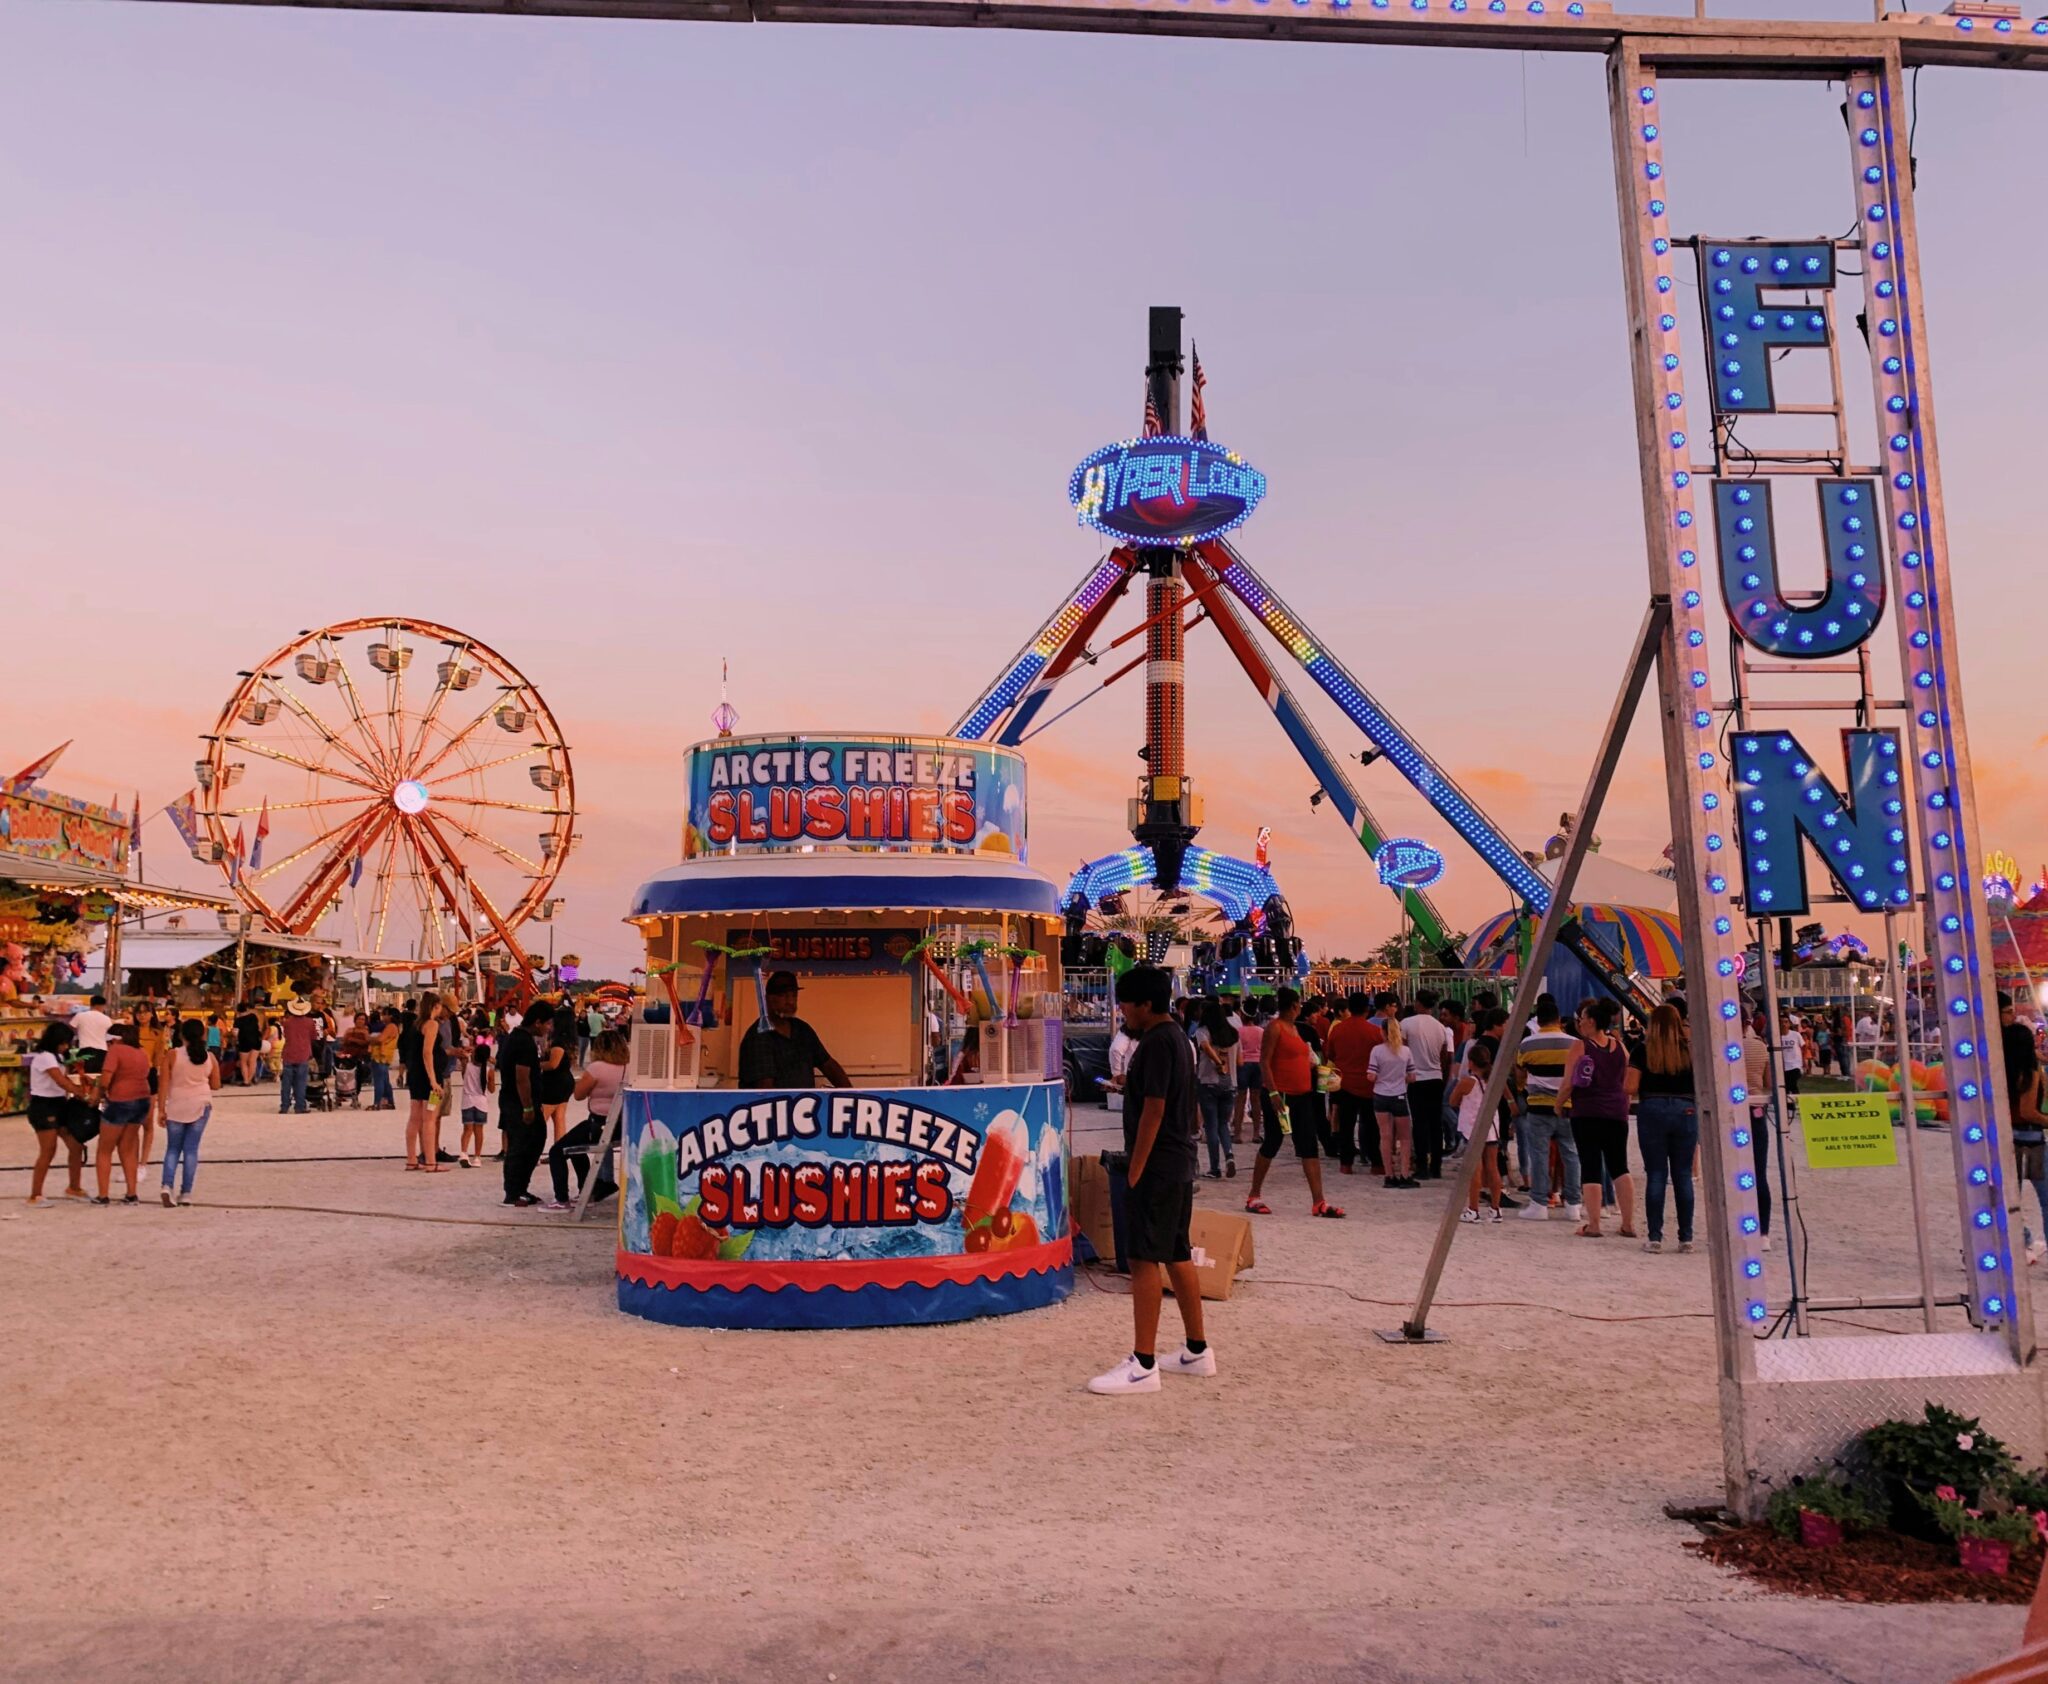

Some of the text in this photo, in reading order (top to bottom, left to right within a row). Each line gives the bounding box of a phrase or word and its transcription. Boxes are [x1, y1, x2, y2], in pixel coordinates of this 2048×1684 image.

[1078, 449, 1184, 526] HYPER
[1698, 236, 1914, 919] FUN
[709, 750, 975, 787] ARCTIC FREEZE
[708, 786, 976, 843] SLUSHIES
[769, 936, 873, 960] SLUSHIES
[1811, 1110, 1880, 1119] WANTED
[1821, 1100, 1866, 1108] HELP
[680, 1096, 977, 1175] ARCTIC FREEZE
[699, 1163, 949, 1224] SLUSHIES
